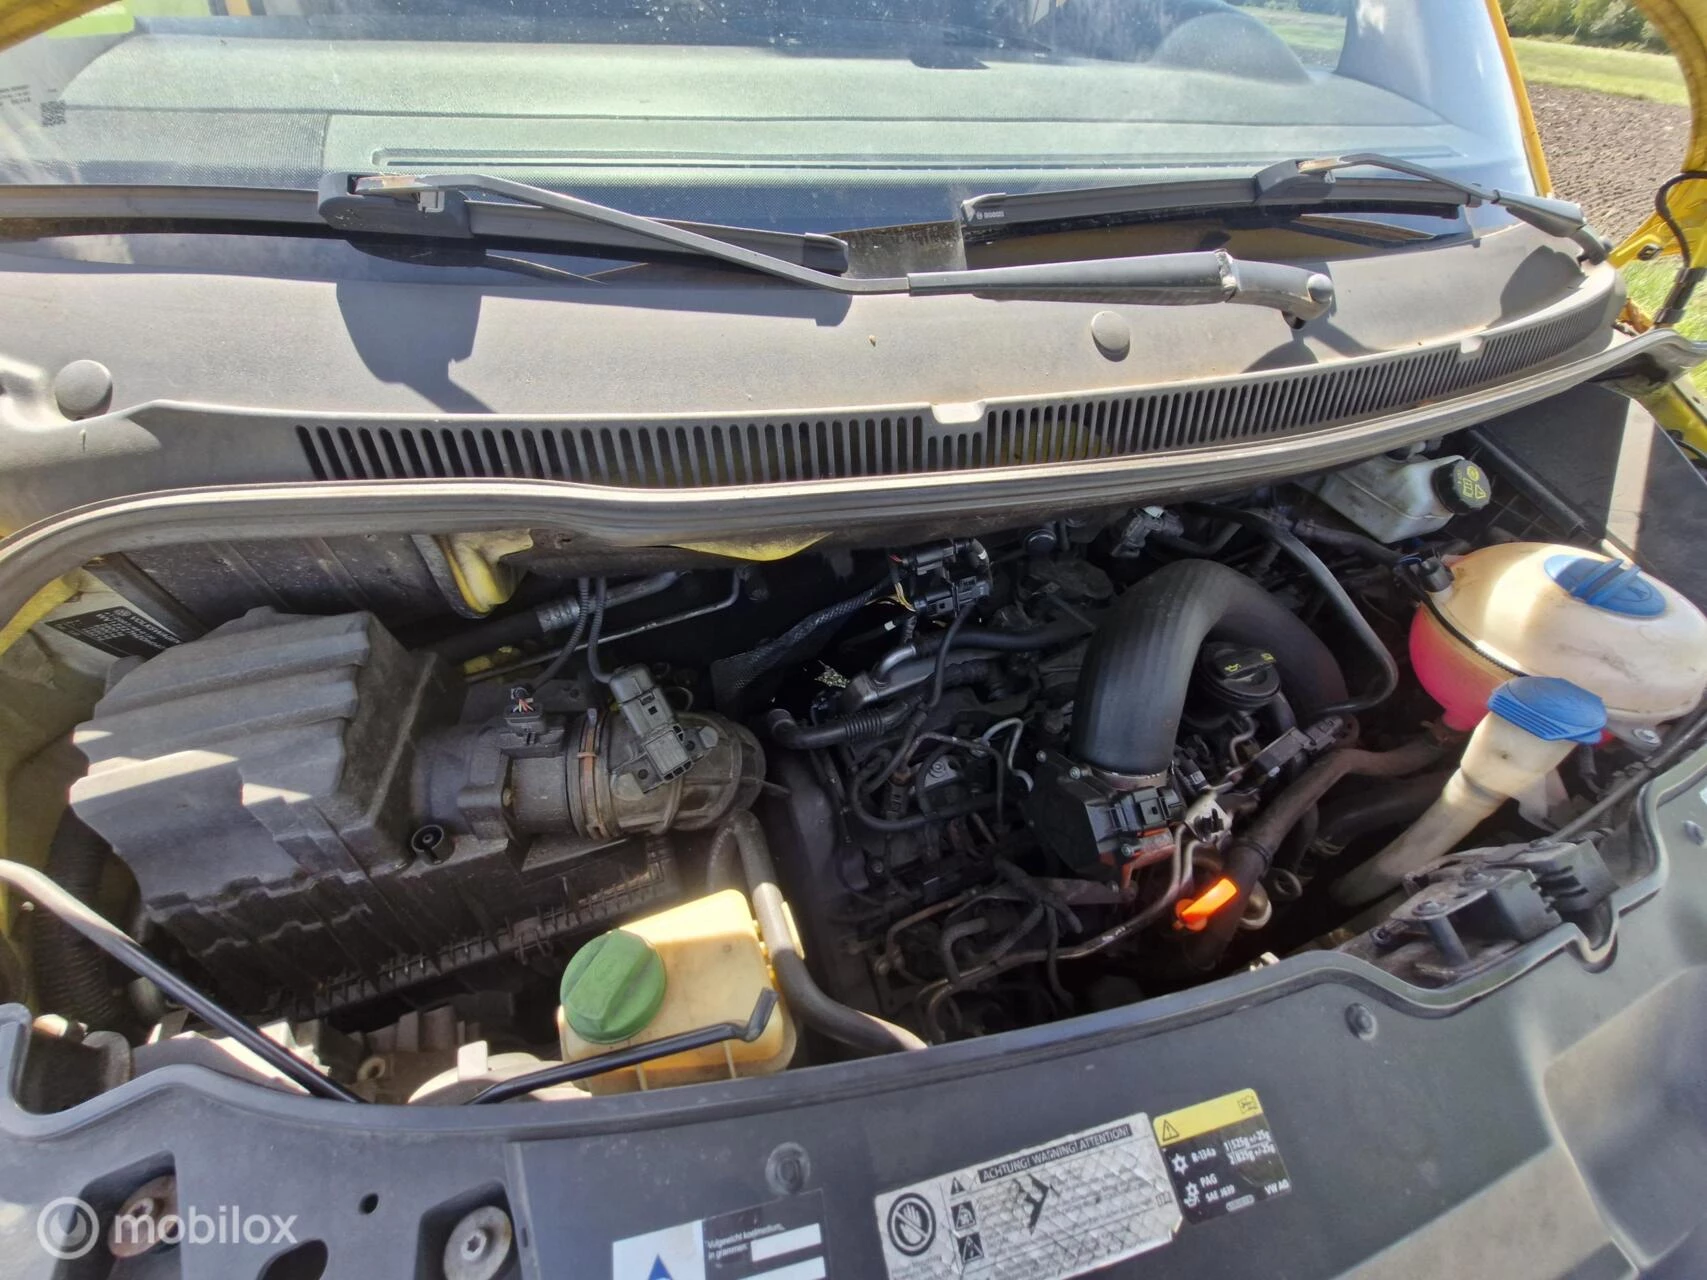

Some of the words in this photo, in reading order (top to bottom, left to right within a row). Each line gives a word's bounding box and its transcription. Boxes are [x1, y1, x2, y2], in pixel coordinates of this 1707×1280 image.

[982, 1157, 1031, 1181] ACHTUNG!
[1079, 1125, 1130, 1150] ATTENTION!
[1200, 1173, 1218, 1188] PAG
[1264, 1182, 1278, 1195] VW
